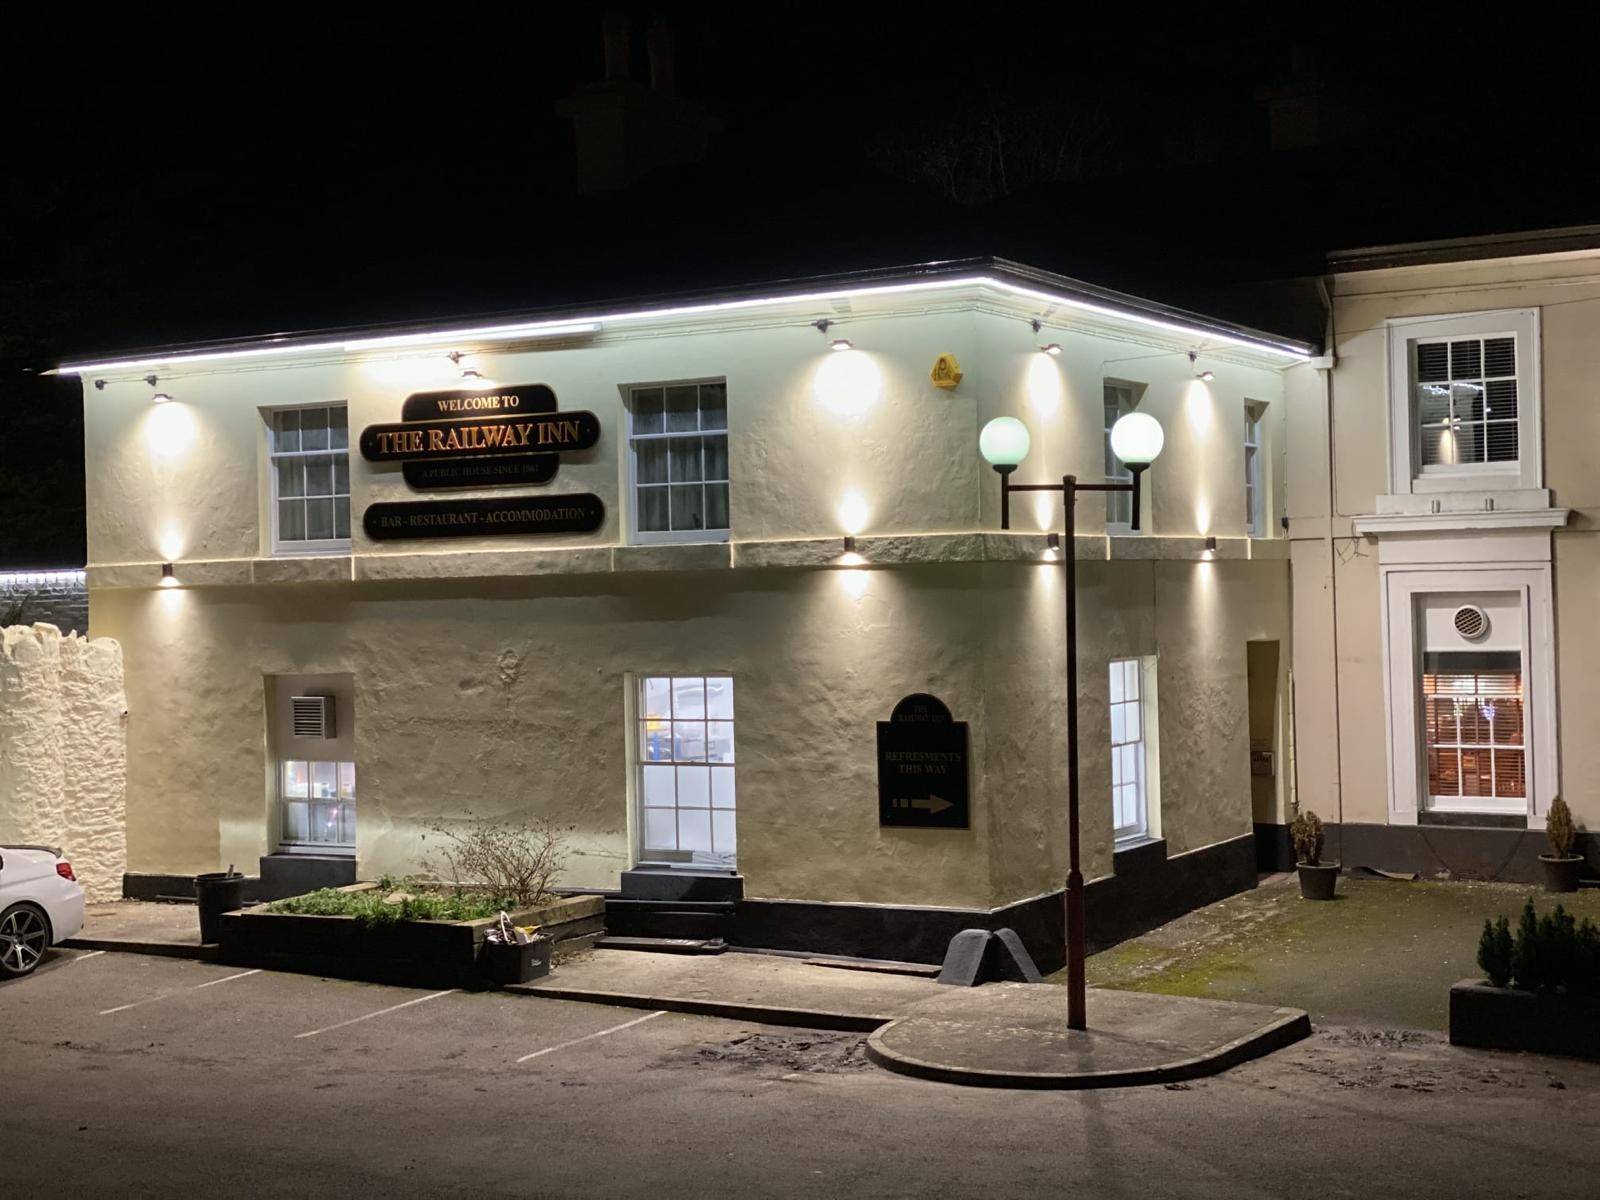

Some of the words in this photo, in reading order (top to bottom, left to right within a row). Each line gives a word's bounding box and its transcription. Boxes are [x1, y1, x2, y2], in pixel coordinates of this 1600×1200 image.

[437, 396, 499, 412] WELCOME
[502, 395, 520, 408] TO
[377, 430, 424, 454] THE
[428, 423, 533, 452] RAILWAY
[537, 420, 581, 444] INN
[461, 465, 491, 477] HOUSE
[493, 463, 518, 475] SINCE
[381, 516, 402, 528] BAR
[410, 512, 477, 527] RESTAURANT
[485, 508, 586, 524] ACCOMMODATION
[898, 763, 921, 774] THIS
[923, 763, 946, 774] WAY
